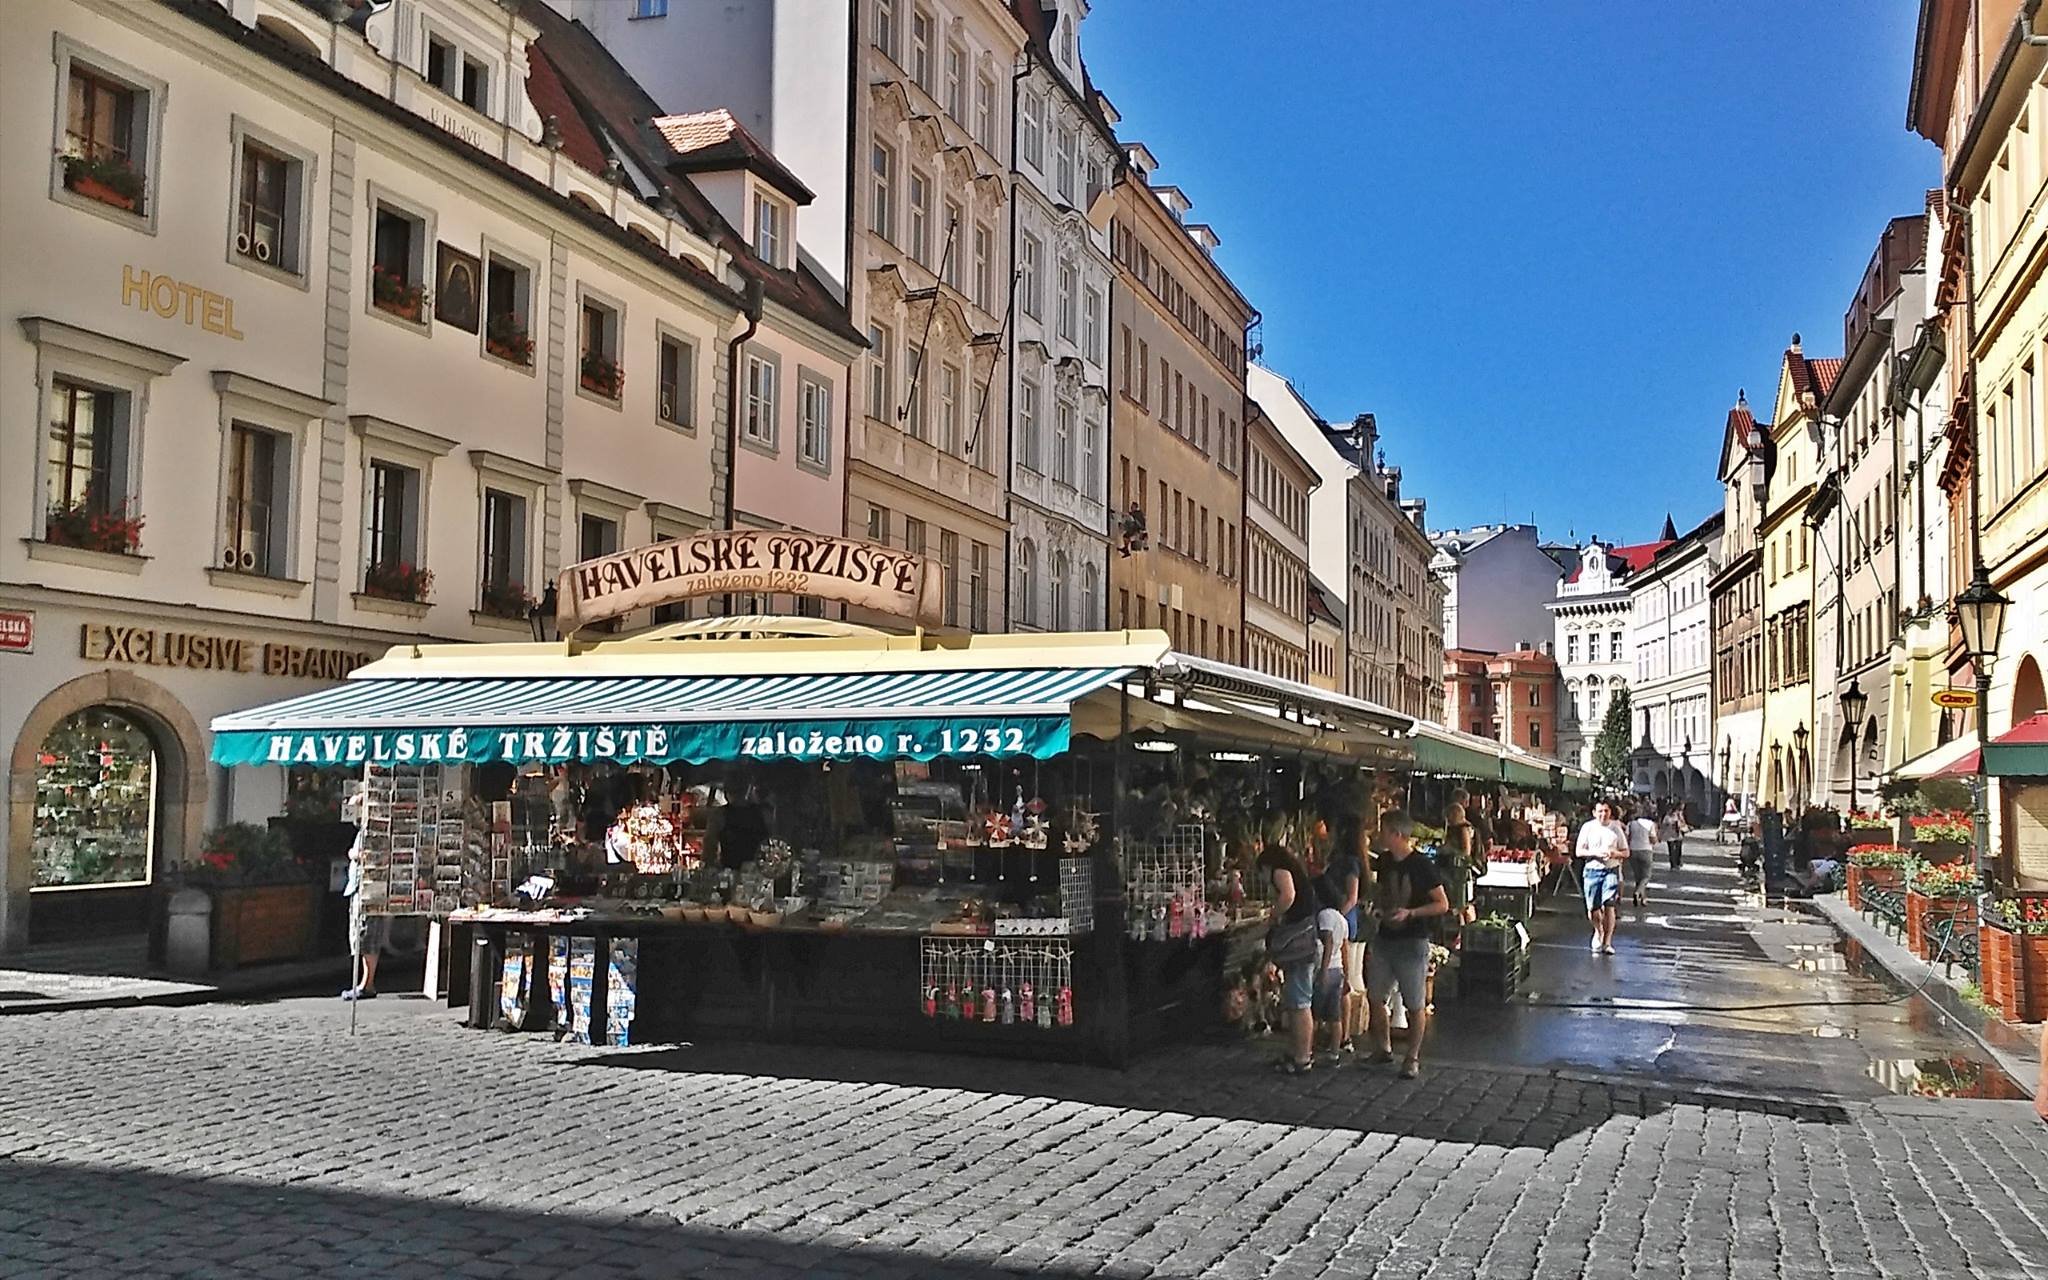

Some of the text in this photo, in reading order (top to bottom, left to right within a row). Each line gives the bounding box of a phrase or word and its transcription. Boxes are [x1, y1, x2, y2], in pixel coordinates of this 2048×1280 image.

[121, 264, 244, 341] HOTEL
[579, 531, 921, 601] HAVELSKÉ TRŽIŠTĚ
[768, 569, 809, 592] 1232
[80, 623, 255, 673] EXCLUSIVE
[267, 725, 1025, 761] HAVELSKÉ TRŽIŠTĚ založeno r. 1232
